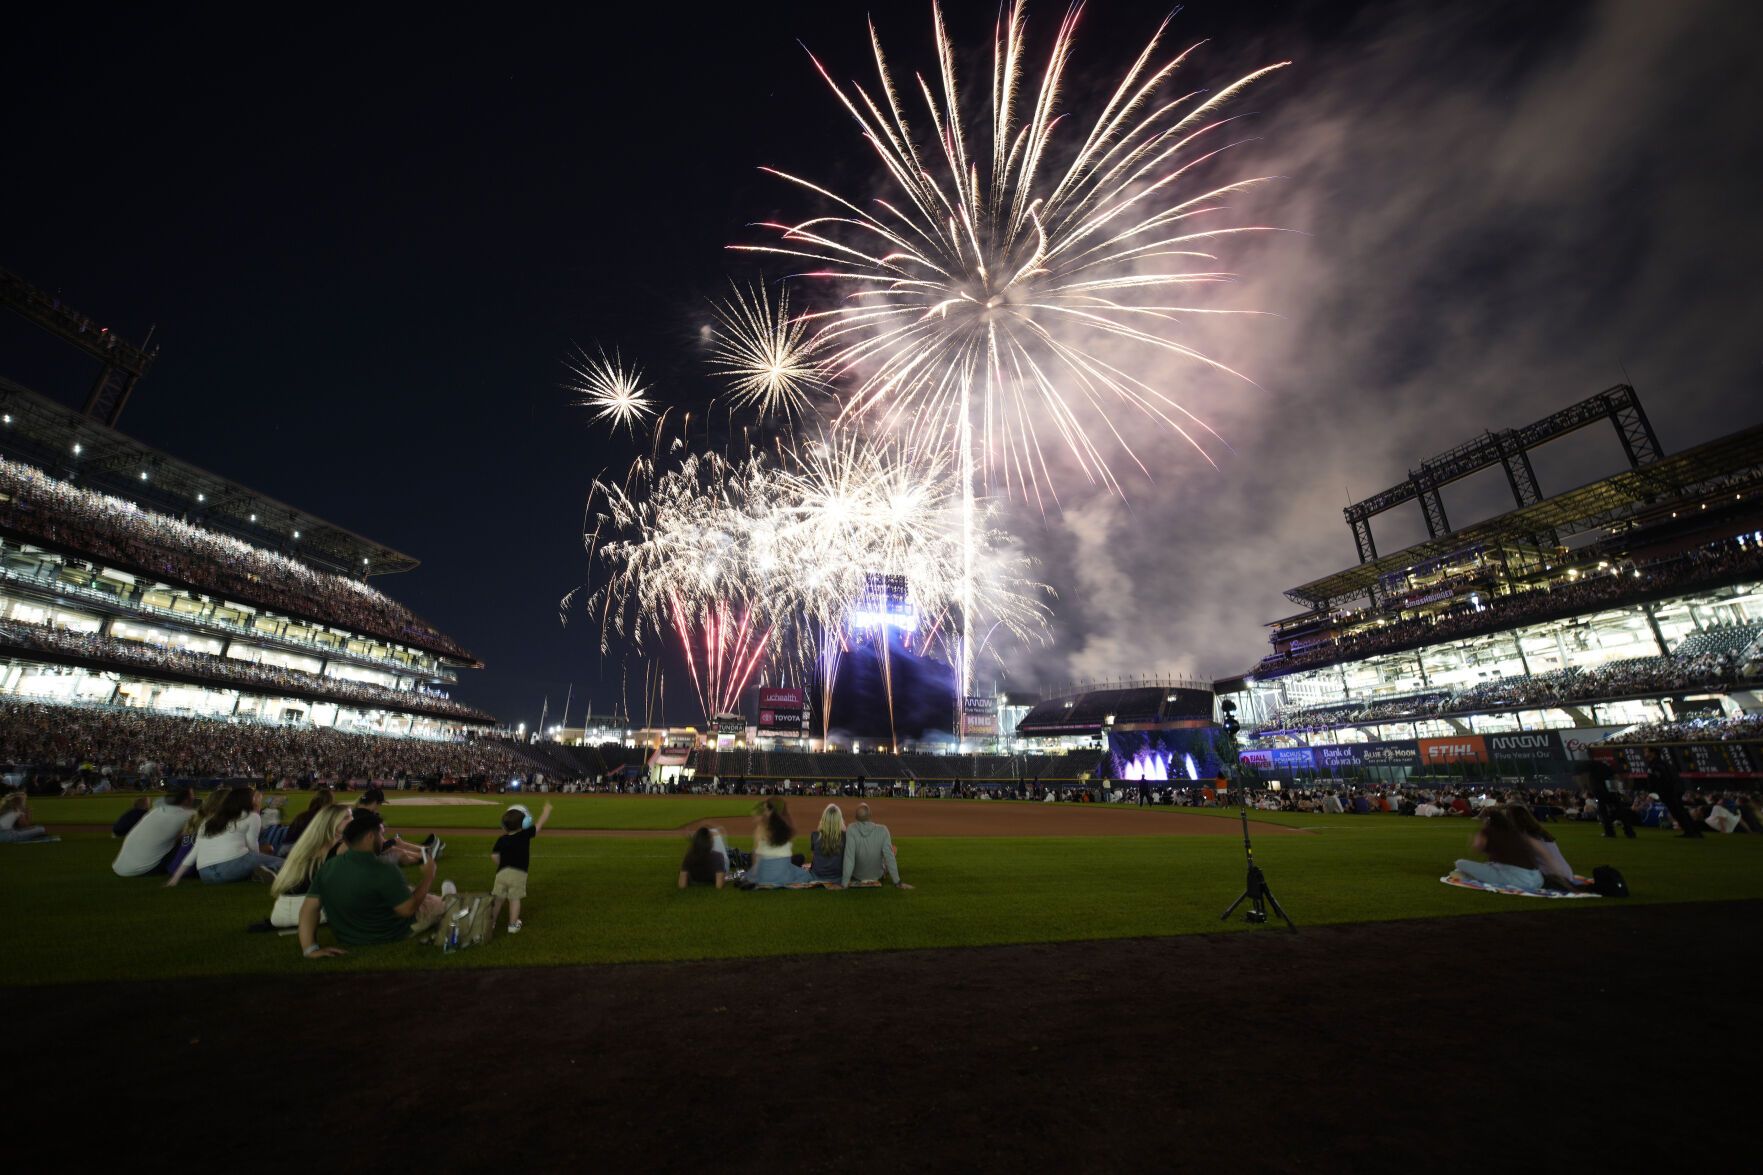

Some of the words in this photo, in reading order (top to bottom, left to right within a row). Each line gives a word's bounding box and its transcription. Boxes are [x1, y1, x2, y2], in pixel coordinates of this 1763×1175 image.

[766, 693, 797, 702] uchealth
[965, 698, 992, 707] ARROW
[775, 714, 801, 722] TOYOTA
[968, 716, 991, 726] KING
[1492, 734, 1549, 749] ARROW
[1323, 749, 1342, 757] Bank
[1343, 747, 1352, 756] of
[1364, 750, 1381, 760] BLUE
[1395, 749, 1416, 757] MOON
[1428, 744, 1475, 757] STIHL
[1326, 756, 1361, 766] Colorado
